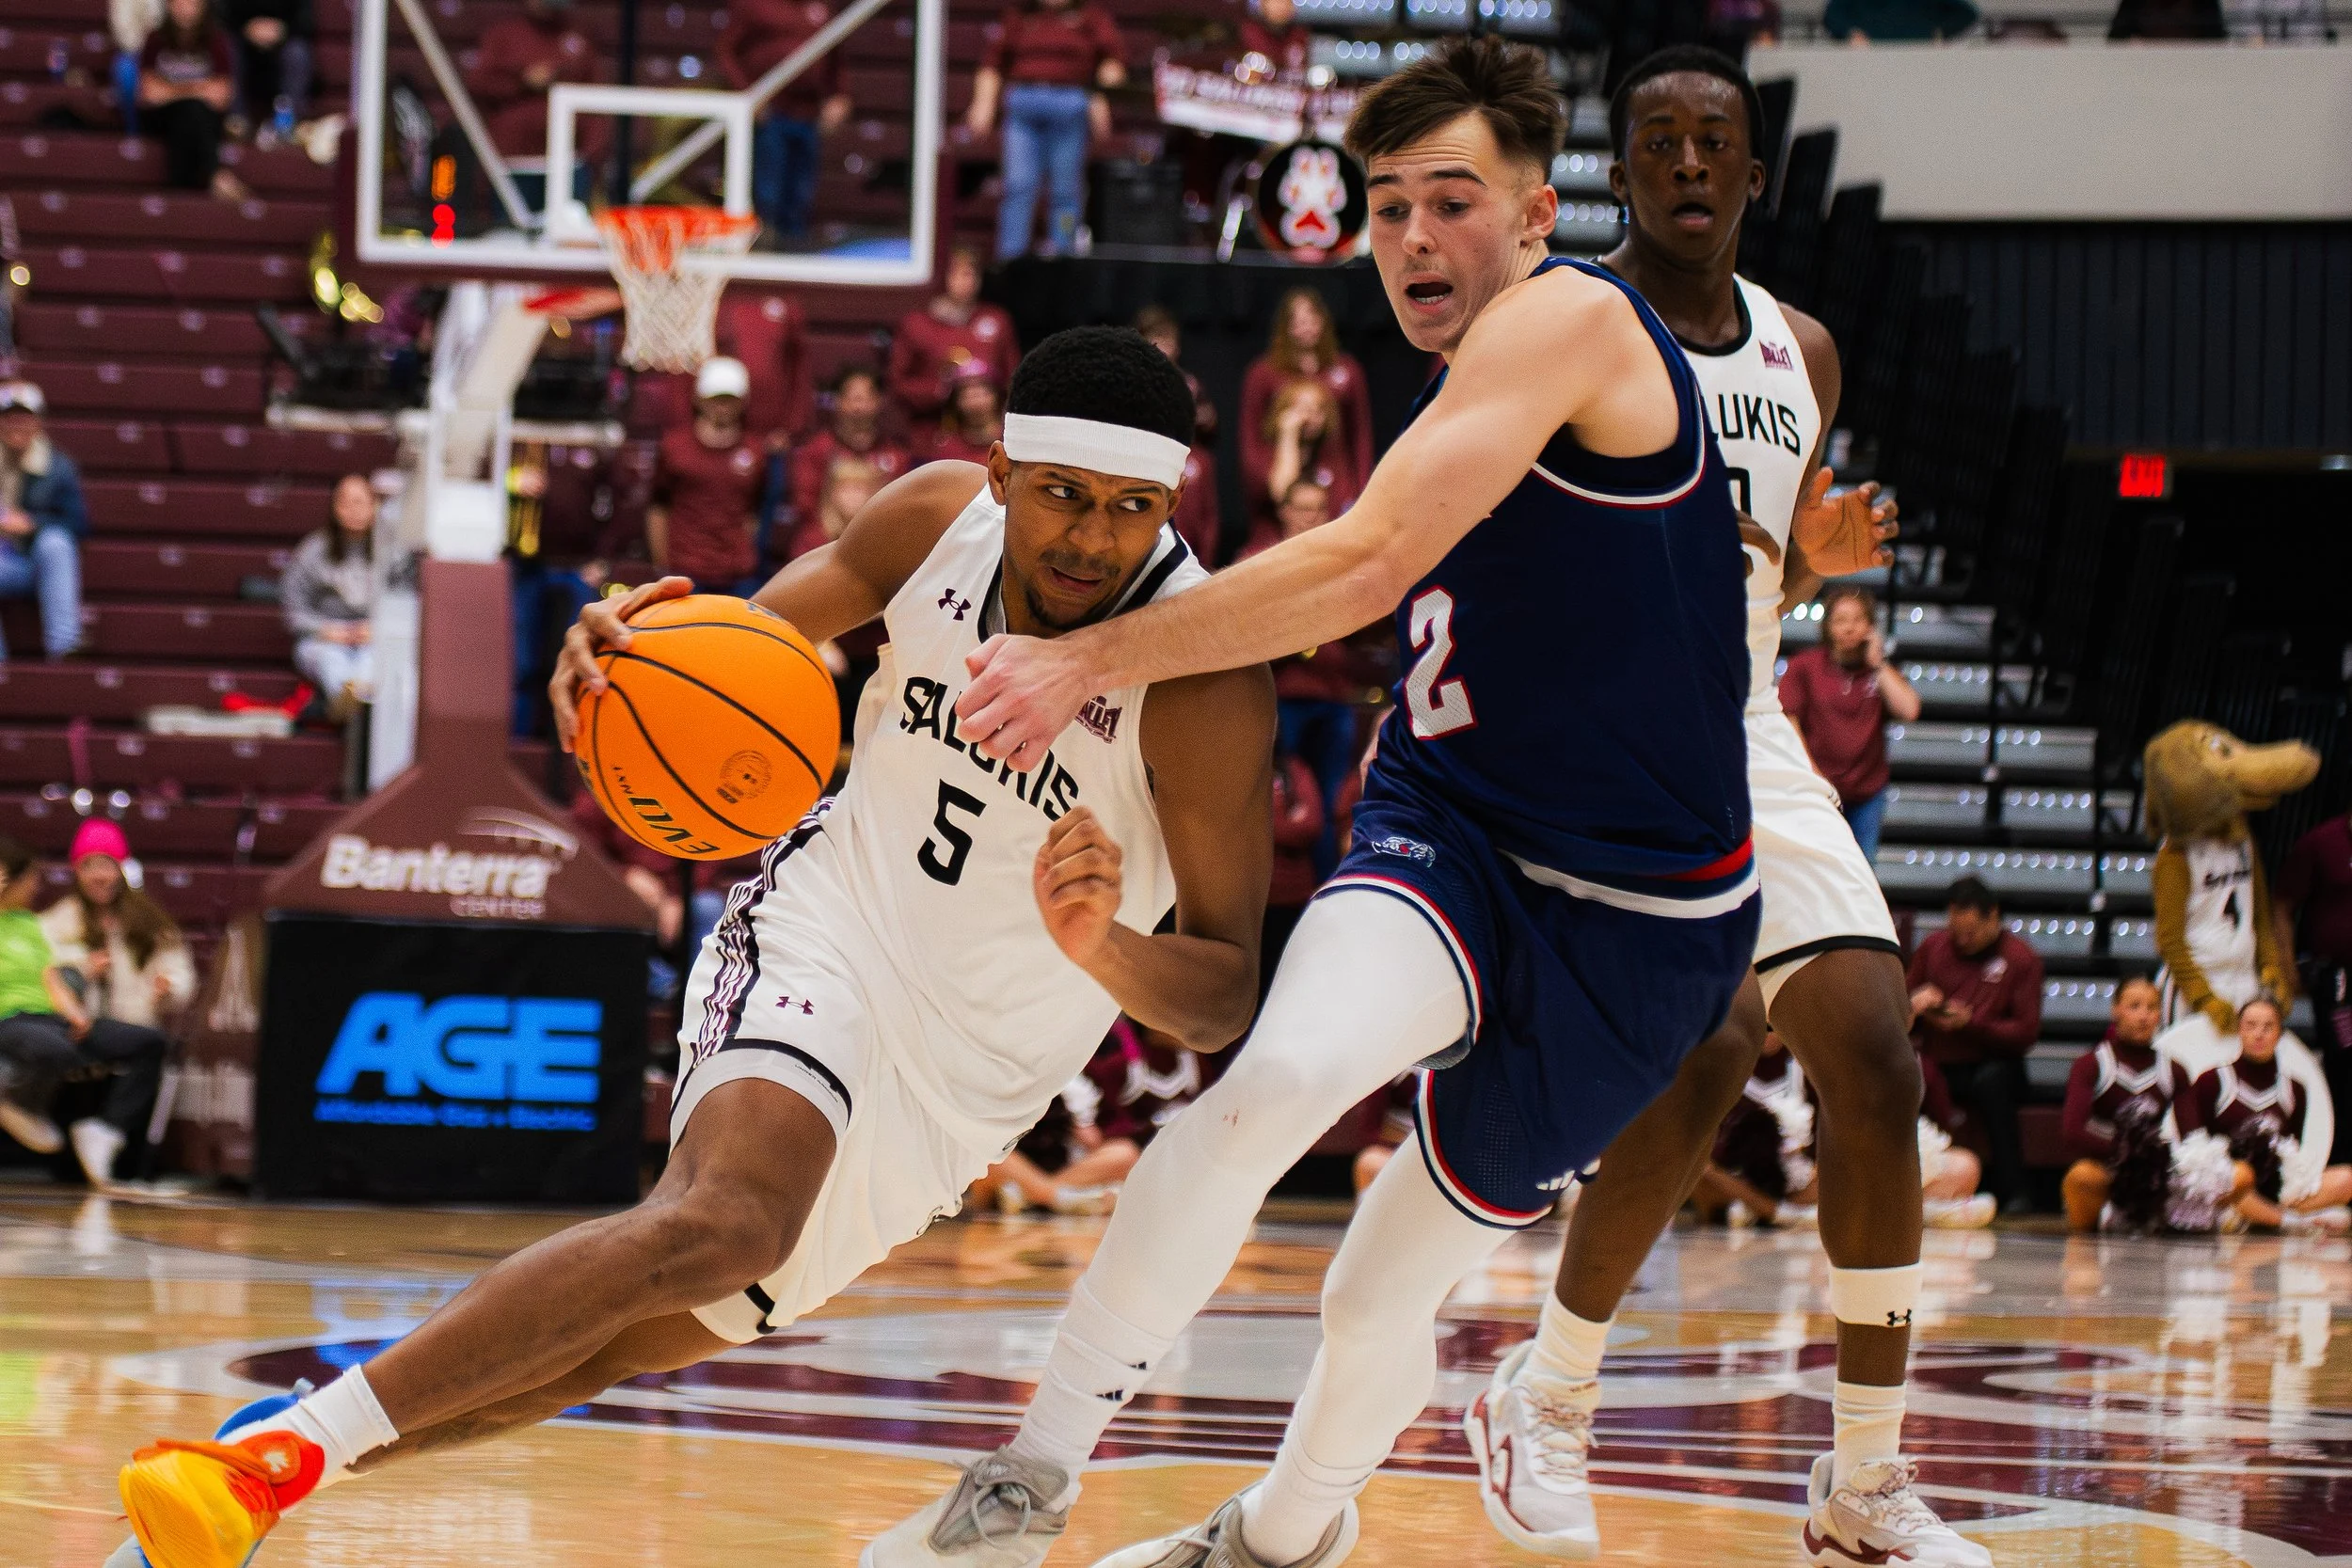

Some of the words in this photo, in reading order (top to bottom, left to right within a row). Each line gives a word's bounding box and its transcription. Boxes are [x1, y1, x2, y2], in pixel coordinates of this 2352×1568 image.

[1712, 393, 1801, 458] UKIS
[1404, 584, 1479, 740] 2
[1078, 697, 1123, 737] ALLEY
[628, 797, 721, 855] EVO
[917, 778, 988, 886] 5
[321, 834, 549, 899] Banterra
[2223, 890, 2241, 929] 4
[315, 991, 604, 1103] AGE
